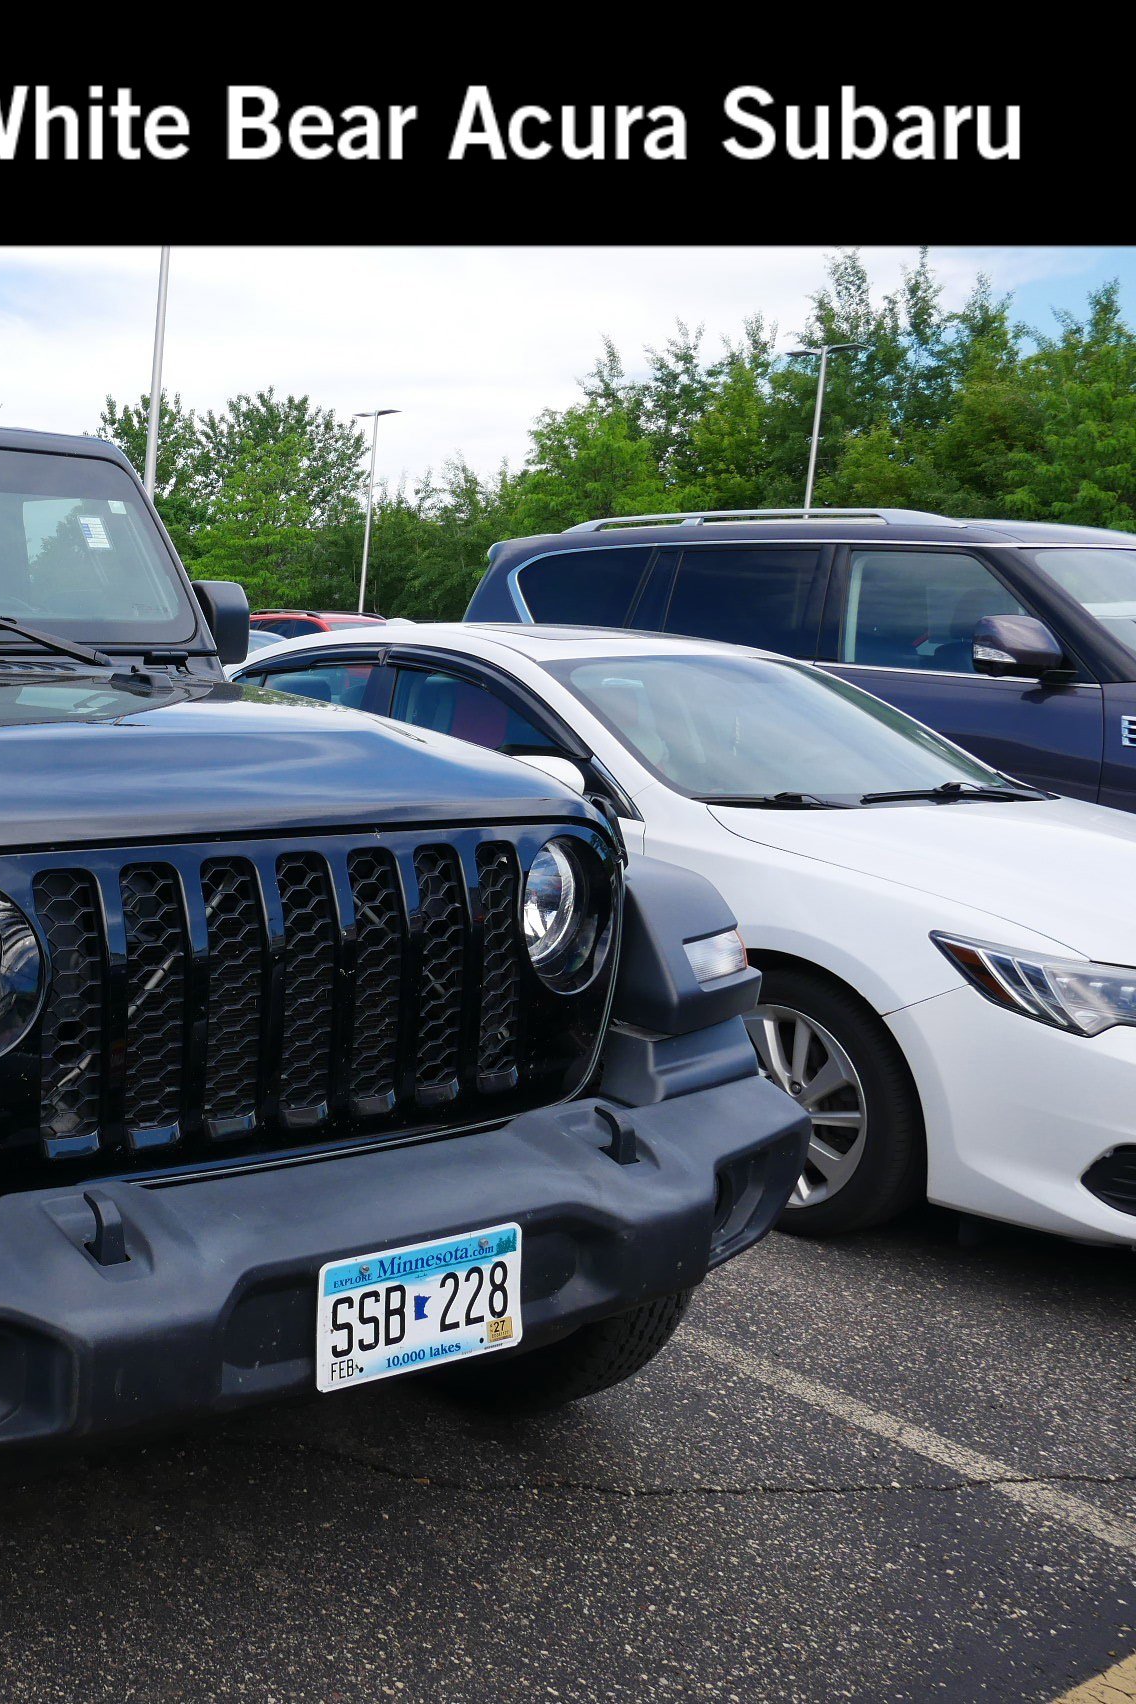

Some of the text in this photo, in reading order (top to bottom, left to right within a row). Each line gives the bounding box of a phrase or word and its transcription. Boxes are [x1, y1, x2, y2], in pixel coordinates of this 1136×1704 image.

[333, 1273, 373, 1289] EXPLORE
[331, 1260, 509, 1359] SSB 228
[493, 1319, 506, 1333] 27
[385, 1349, 426, 1369] 10,000
[429, 1342, 462, 1358] lakes
[330, 1358, 354, 1382] FEB
